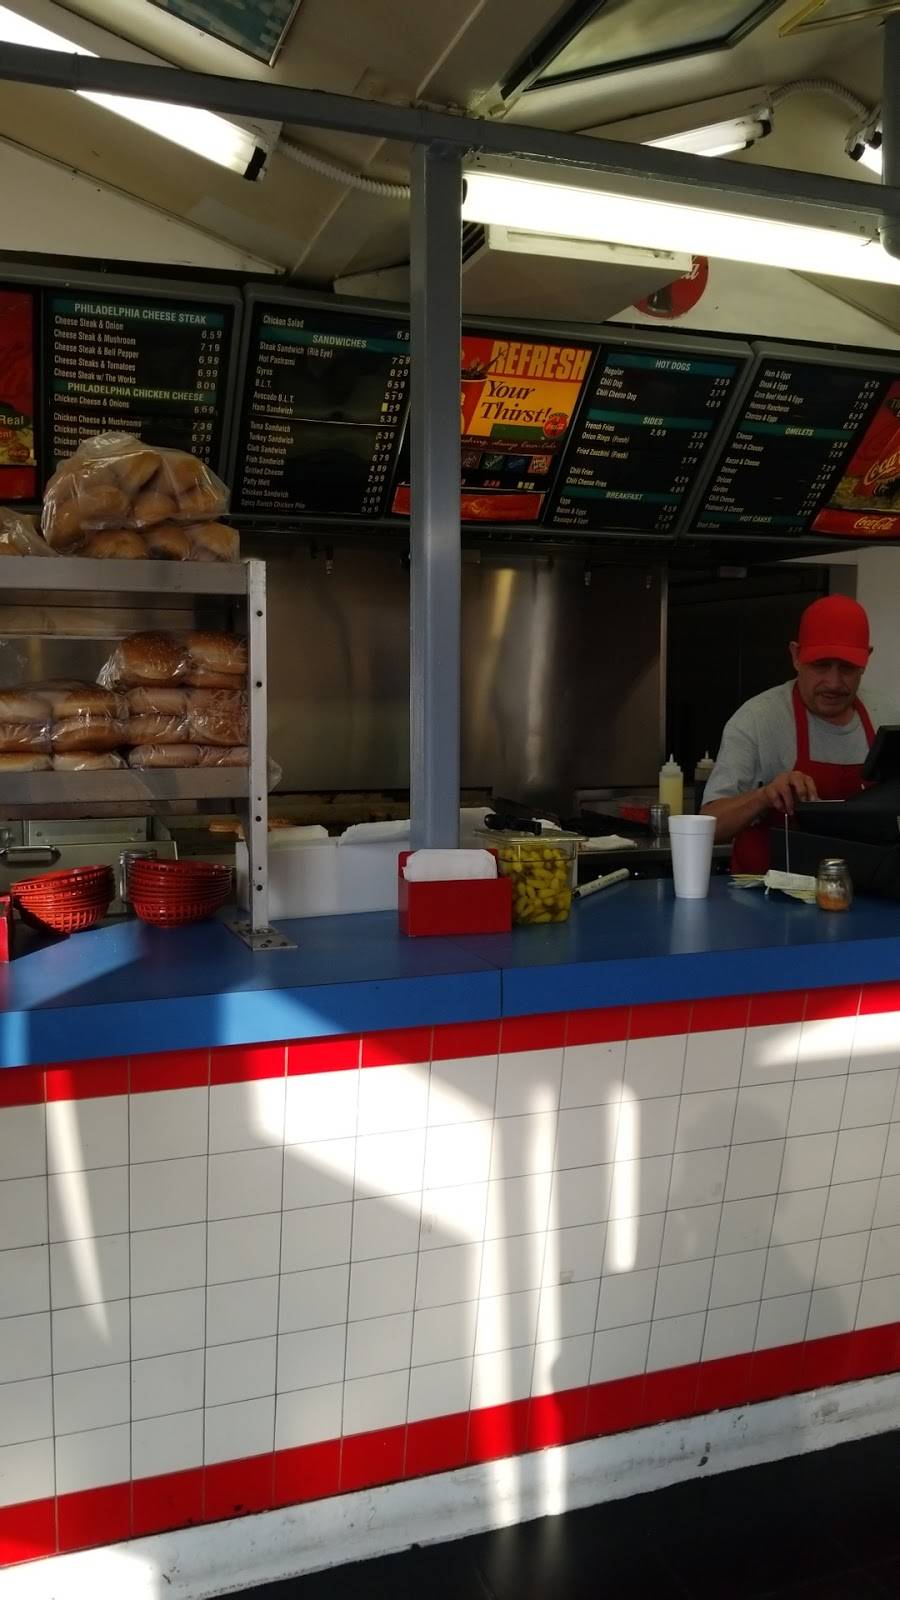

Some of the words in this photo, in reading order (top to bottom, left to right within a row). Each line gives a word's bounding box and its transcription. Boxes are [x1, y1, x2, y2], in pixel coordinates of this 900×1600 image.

[75, 303, 140, 319] PHILADELPHIA
[142, 309, 176, 322] CHEESE
[178, 313, 207, 325] STEAK
[54, 315, 79, 326] Cheese
[80, 318, 98, 328] Steak
[105, 320, 124, 330] Onion
[262, 314, 287, 327] Chicken
[286, 317, 305, 328] Salad
[54, 328, 77, 339] Cheese
[78, 331, 96, 342] Steak
[104, 334, 137, 346] Mushroom
[312, 334, 368, 349] SANDWICHES
[54, 341, 77, 353] Cheese
[78, 344, 96, 355] Steak
[117, 348, 139, 360] Pepper
[259, 341, 277, 352] Steak
[276, 343, 305, 355] Sandwich
[54, 354, 77, 366] Cheese
[488, 340, 592, 380] REFRESH
[655, 359, 671, 370] HOT
[670, 362, 692, 373] DOGS
[54, 367, 77, 379] Cheese
[78, 371, 95, 381] Steak
[117, 375, 137, 385] Works
[255, 365, 273, 376] Gyros
[603, 366, 625, 377] Regular
[488, 380, 536, 400] Your
[612, 379, 624, 390] Dog
[67, 382, 131, 396] PHILADELPHIA
[133, 387, 170, 400] CHICKEN
[172, 391, 205, 402] CHEESE
[608, 390, 627, 400] Cheese
[626, 392, 638, 403] Dog
[54, 393, 78, 404] Chicken
[79, 396, 102, 406] Cheese
[266, 405, 294, 416] Sandwich
[481, 402, 553, 423] Thirst!
[0, 414, 24, 425] Real
[54, 412, 78, 423] Chicken
[79, 414, 101, 425] Cheese
[585, 420, 602, 430] French
[642, 416, 665, 427] SIDES
[54, 424, 78, 434] Chicken
[264, 423, 291, 433] Sandwich
[785, 427, 815, 437] OMELETS
[267, 434, 295, 445] Sandwich
[260, 445, 287, 455] Sandwich
[258, 457, 286, 467] Sandwich
[605, 491, 644, 502] BREAKFAST
